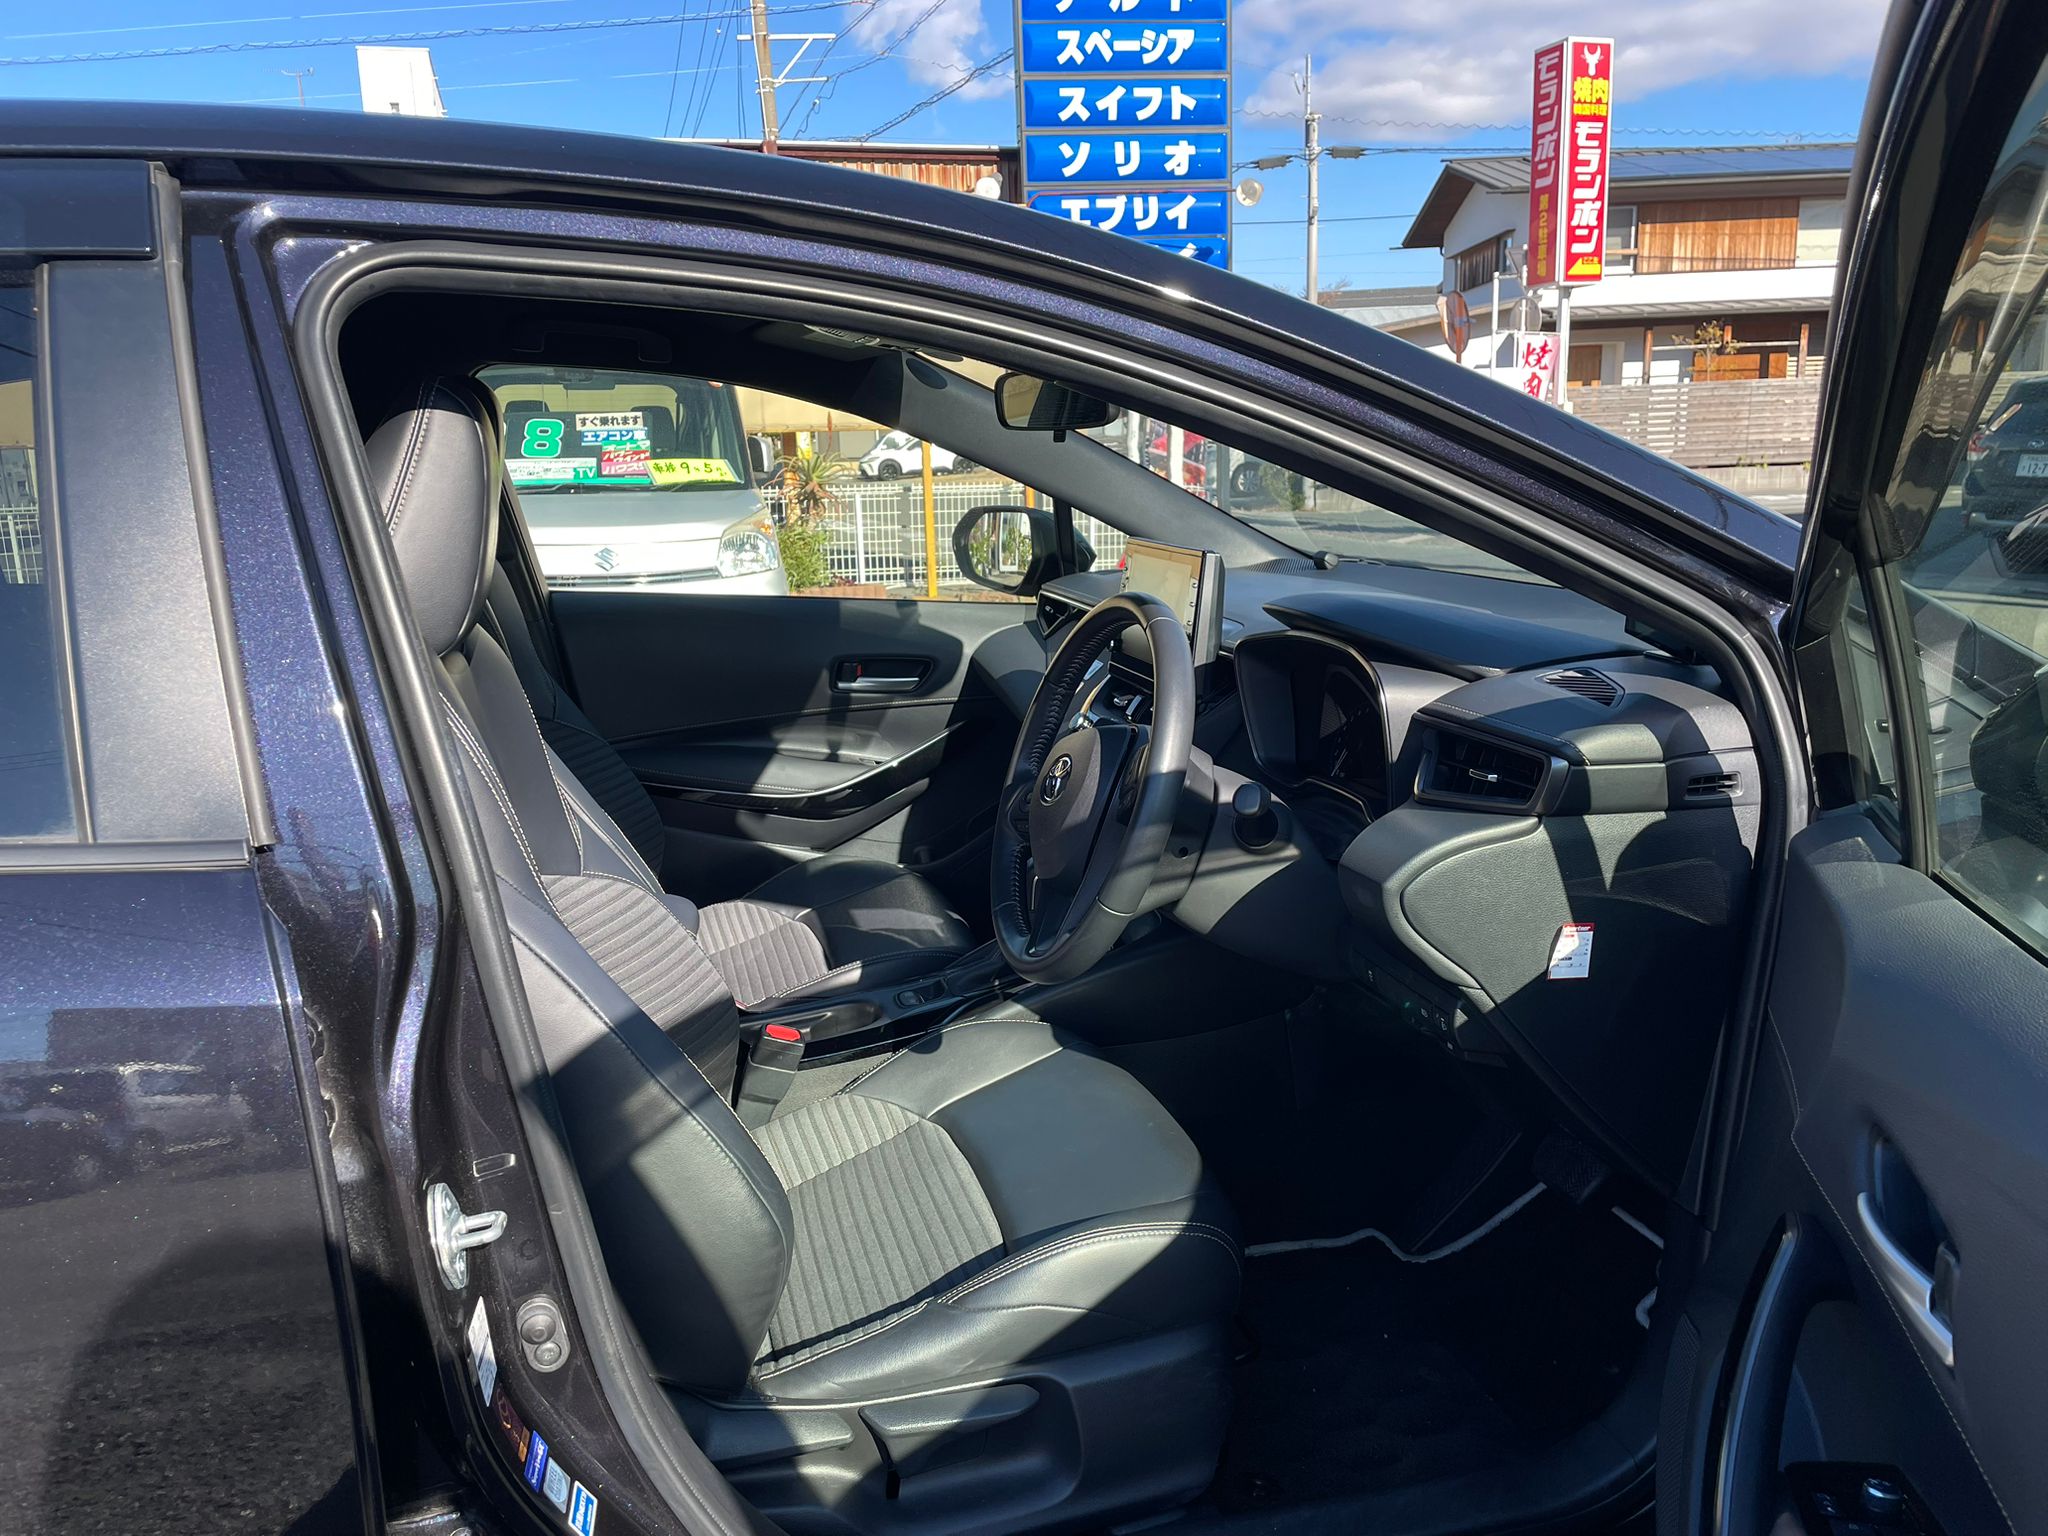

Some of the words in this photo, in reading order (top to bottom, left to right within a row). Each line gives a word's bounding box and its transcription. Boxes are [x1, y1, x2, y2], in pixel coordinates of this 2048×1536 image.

[1056, 28, 1195, 65] スペーシア
[1057, 85, 1198, 122] スイフト
[1534, 51, 1560, 189] モランボン
[1058, 140, 1197, 177] ソリオ
[1570, 121, 1604, 254] モランボン
[1060, 194, 1197, 231] エブリイ
[521, 418, 564, 458] 8
[578, 415, 642, 428] すぐ乗れます
[583, 429, 647, 442] エアコン車
[576, 467, 596, 479] TV
